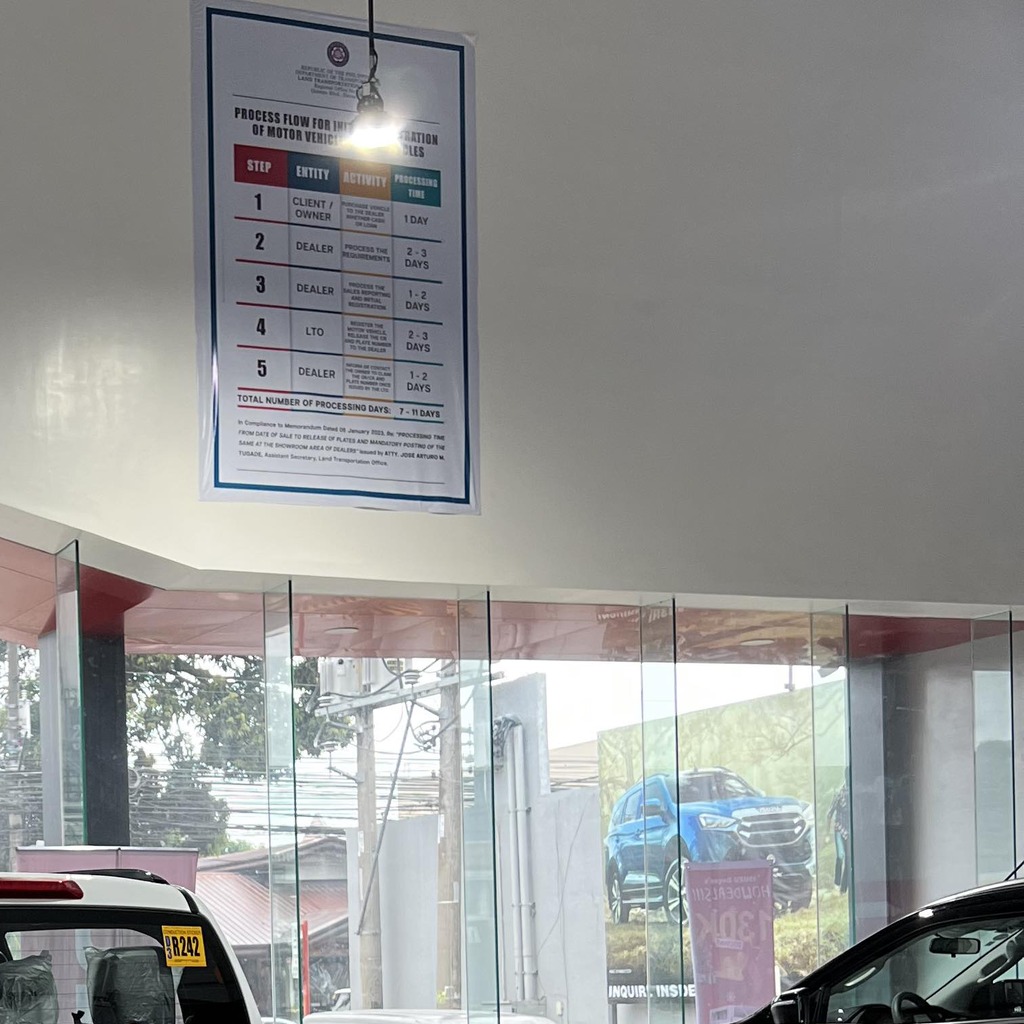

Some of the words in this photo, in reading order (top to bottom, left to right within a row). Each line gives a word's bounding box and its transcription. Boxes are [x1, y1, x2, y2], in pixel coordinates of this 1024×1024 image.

[235, 107, 280, 124] PROCESS
[283, 114, 310, 128] FLOW
[312, 117, 330, 131] FOR
[252, 124, 264, 136] OF
[267, 126, 302, 141] MOTOR
[247, 159, 272, 173] STEP
[296, 165, 329, 180] ENTITY
[343, 171, 387, 188] ACTIVITY
[395, 174, 438, 188] PROCESSING
[408, 189, 424, 199] TIME
[254, 193, 262, 210] 1
[292, 196, 326, 209] CLIENT
[328, 201, 333, 209] /
[295, 210, 331, 220] OWNER
[410, 215, 429, 226] DAY
[255, 232, 264, 250] 2
[296, 242, 334, 254] DEALER
[344, 244, 374, 253] PROCESS
[342, 251, 390, 262] REQUIREMENTS
[421, 249, 427, 257] 3
[405, 259, 429, 270] DAYS
[256, 275, 265, 293] 3
[297, 283, 334, 296] DEALER
[421, 291, 426, 300] 2
[406, 301, 430, 312] DAYS
[257, 318, 266, 336] 4
[306, 327, 324, 337] LTO
[408, 331, 414, 339] 2
[422, 332, 428, 340] 3
[406, 342, 430, 353] DAYS
[257, 360, 267, 377] 5
[298, 367, 335, 379] DEALER
[422, 372, 428, 381] 2
[407, 382, 431, 393] DAYS
[237, 394, 263, 403] TOTAL
[266, 396, 300, 406] NUMBER
[316, 401, 366, 412] PROCESSING
[368, 405, 391, 414] DAYS:
[420, 410, 440, 418] DAYS
[370, 439, 402, 447] MANDATORY
[334, 457, 370, 465] Transportation
[172, 936, 200, 957] R242
